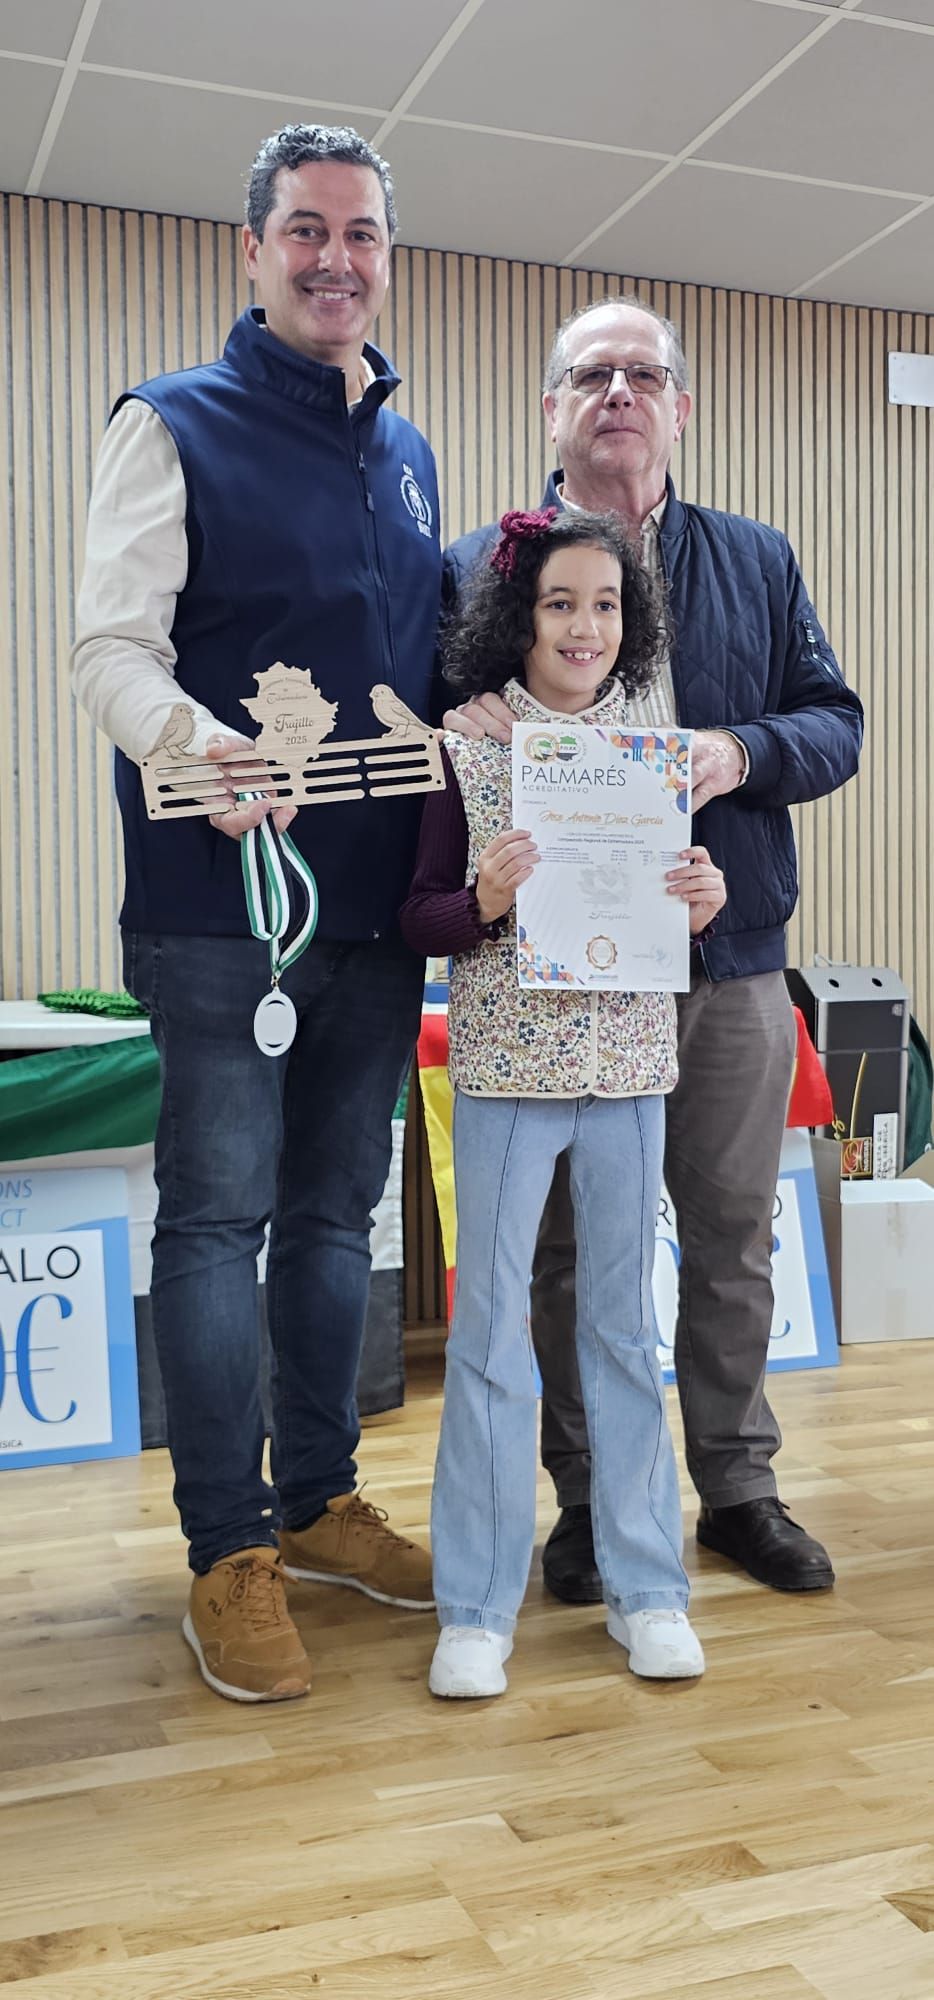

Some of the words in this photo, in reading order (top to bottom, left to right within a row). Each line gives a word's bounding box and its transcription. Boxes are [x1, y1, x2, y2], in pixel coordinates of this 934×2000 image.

[273, 713, 314, 734] Trujillo
[285, 735, 308, 745] 2025
[521, 764, 626, 787] PALMARÉS
[522, 784, 589, 794] ACREDITATIVO
[0, 1178, 33, 1199] NS
